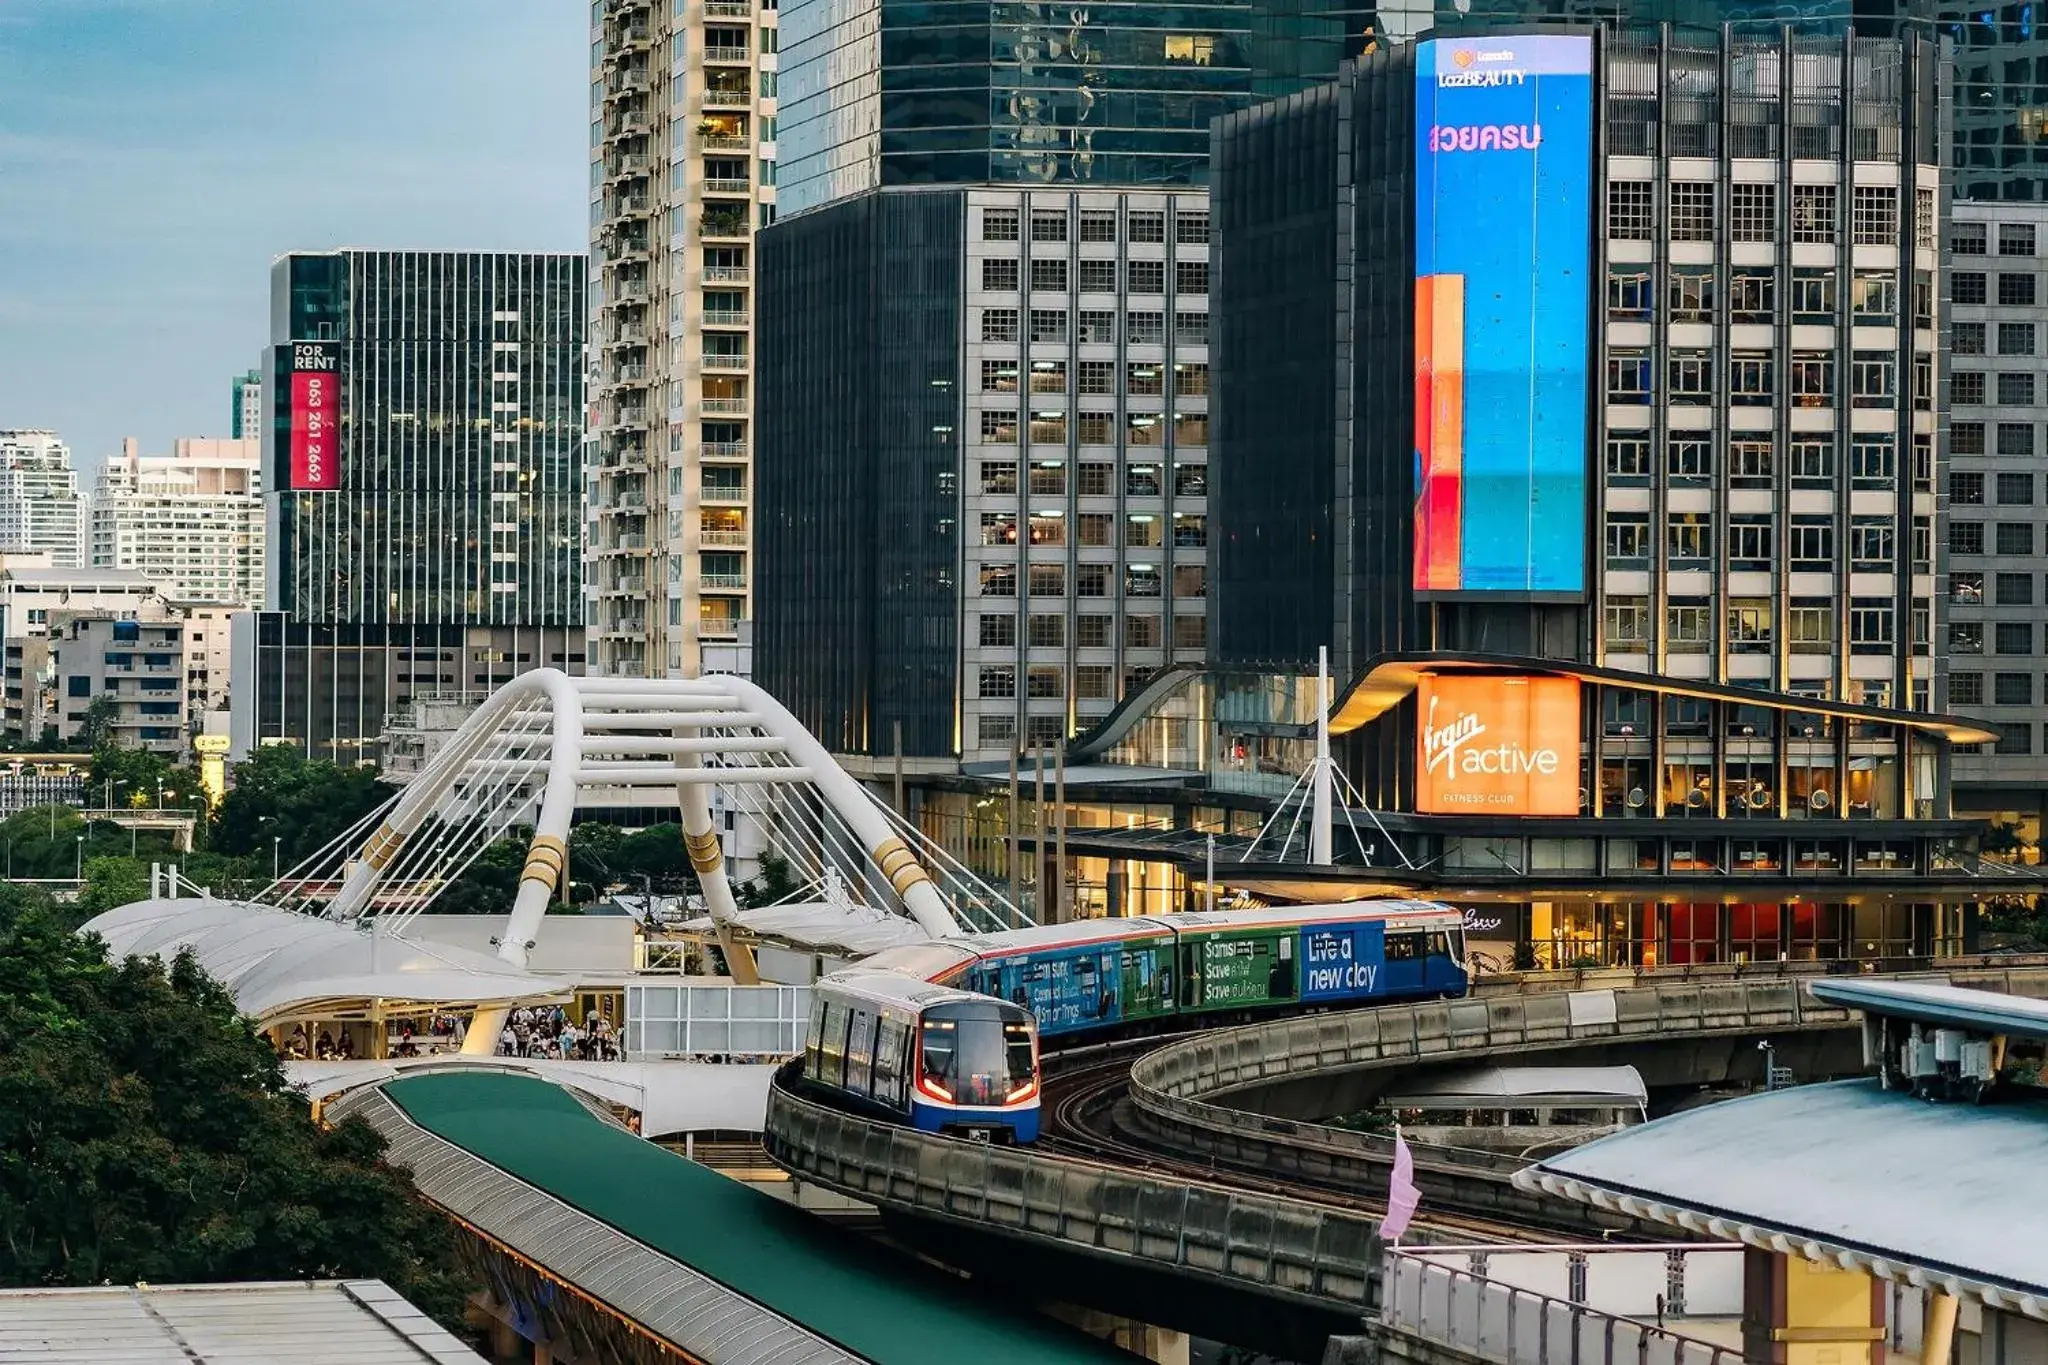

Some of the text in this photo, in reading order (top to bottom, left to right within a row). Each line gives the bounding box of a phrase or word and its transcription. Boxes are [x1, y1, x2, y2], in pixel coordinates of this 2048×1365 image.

[295, 345, 323, 356] FOR
[294, 357, 337, 369] RENT
[307, 379, 322, 482] 063 261 2662
[1461, 741, 1560, 775] active
[1443, 793, 1485, 804] FITNESS
[1206, 963, 1230, 979] Save
[1308, 967, 1343, 991] new
[1206, 983, 1230, 1000] Save
